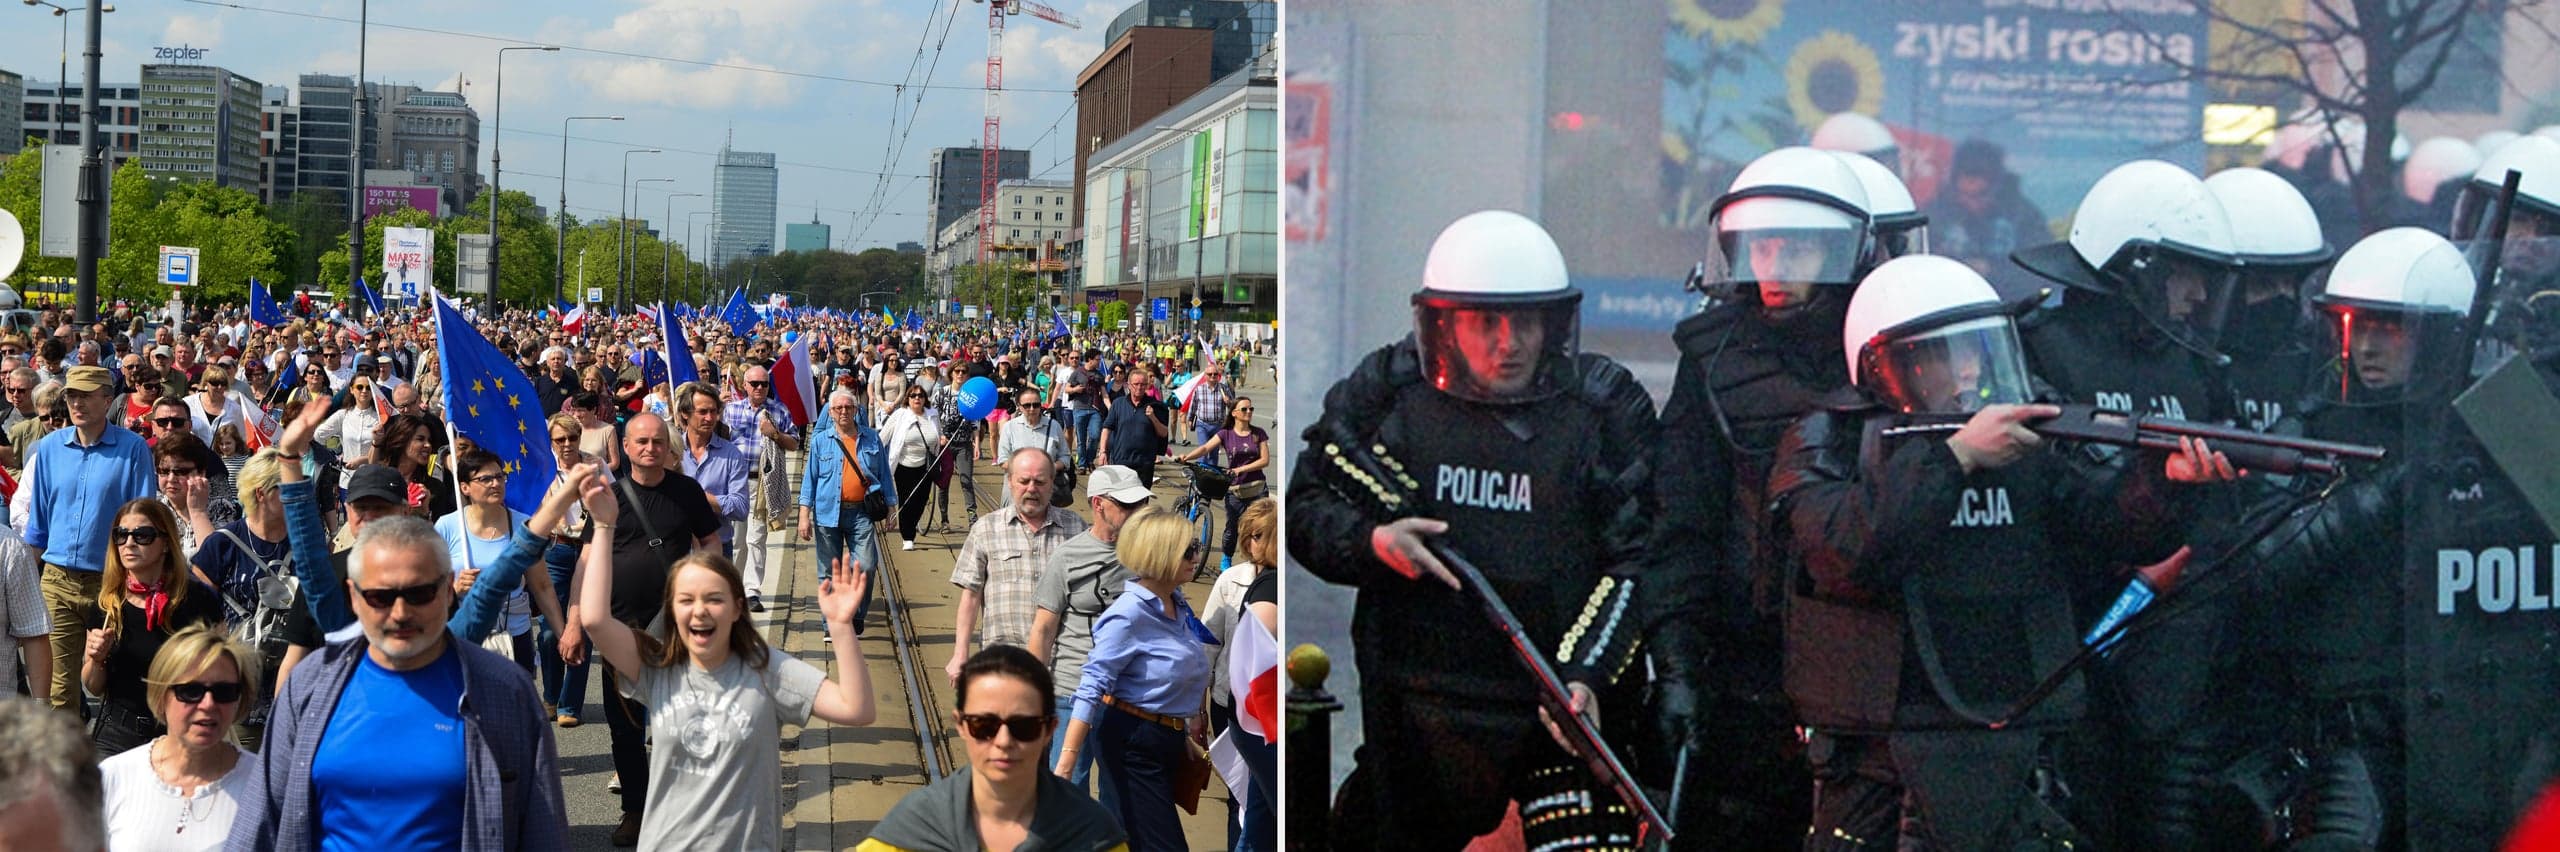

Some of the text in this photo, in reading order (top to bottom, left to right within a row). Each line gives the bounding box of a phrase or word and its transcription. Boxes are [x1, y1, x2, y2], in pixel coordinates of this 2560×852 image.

[1894, 16, 2029, 66] zyski
[153, 43, 209, 65] zepter
[369, 189, 384, 197] 150
[388, 252, 421, 263] MARSZ
[1436, 464, 1532, 512] POLICJA
